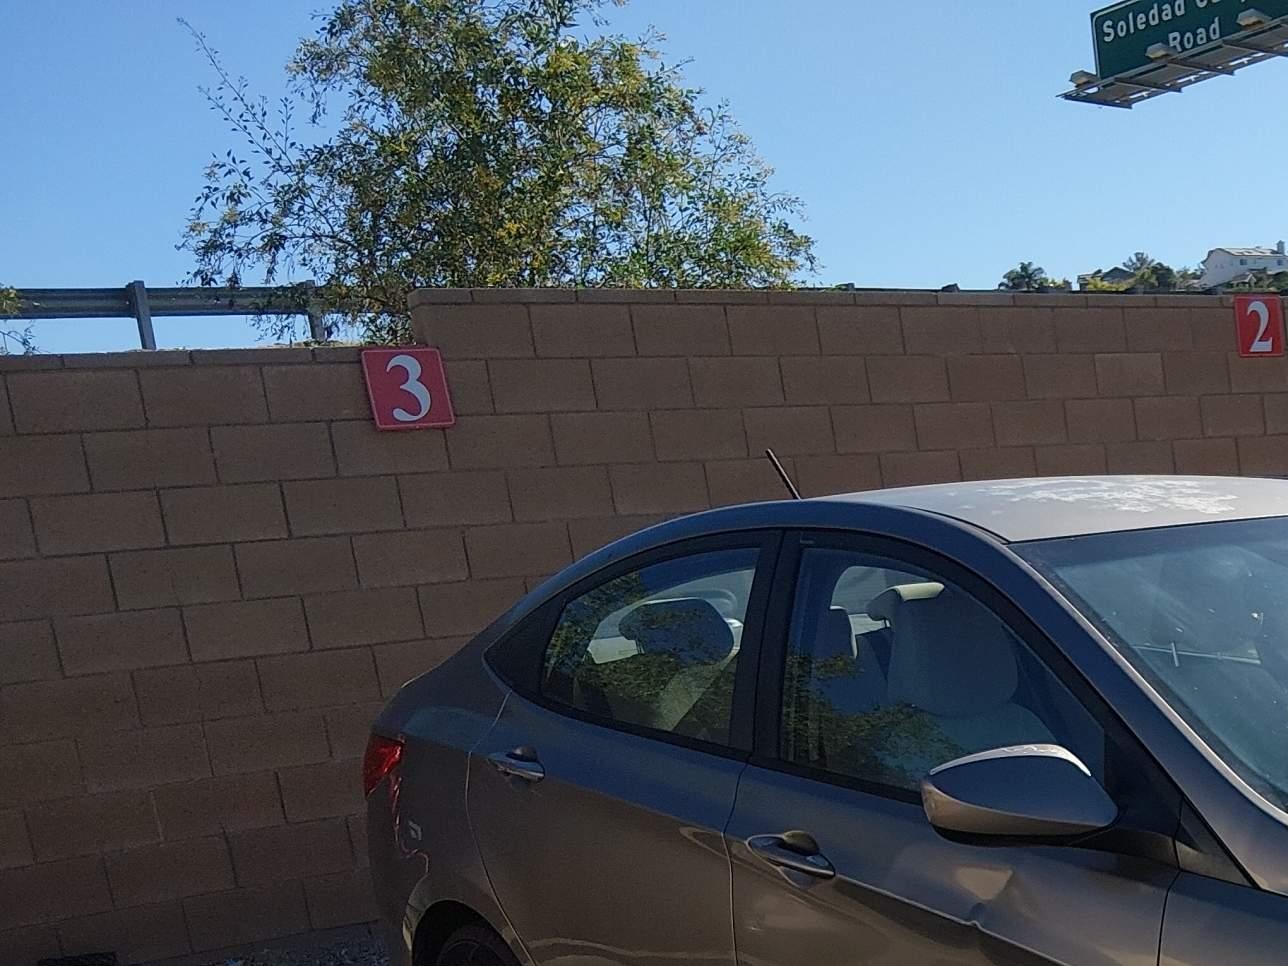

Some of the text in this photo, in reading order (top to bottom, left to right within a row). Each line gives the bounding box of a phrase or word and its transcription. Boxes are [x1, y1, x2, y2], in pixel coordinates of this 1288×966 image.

[1102, 0, 1186, 42] Soledad
[1168, 16, 1220, 52] Road
[1247, 300, 1273, 353] 2
[386, 354, 431, 422] 3
